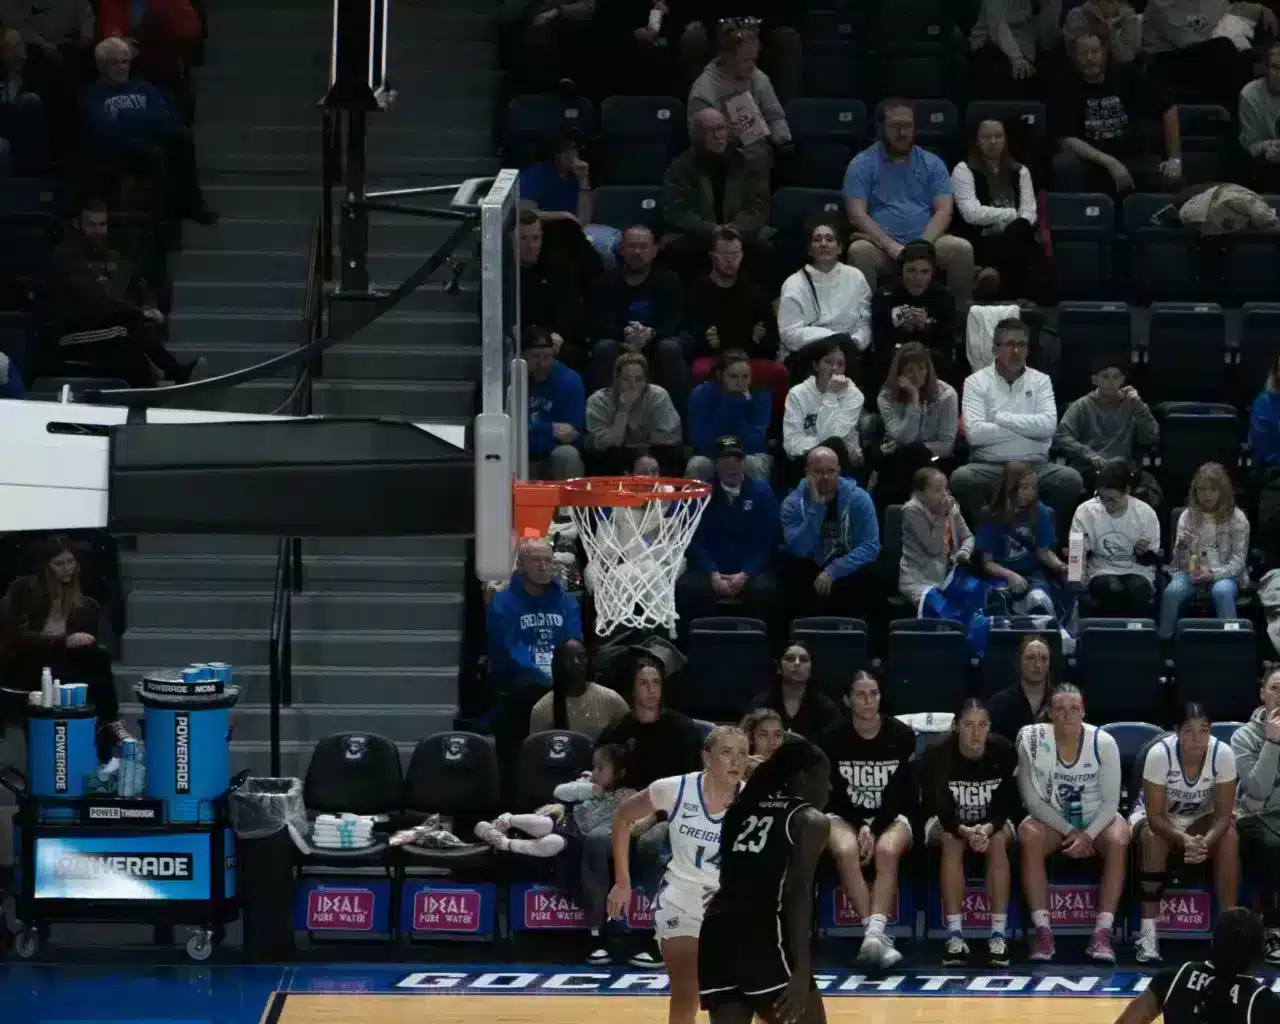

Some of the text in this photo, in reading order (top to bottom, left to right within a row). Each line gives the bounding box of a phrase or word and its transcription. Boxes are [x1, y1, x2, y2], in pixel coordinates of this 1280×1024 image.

[146, 680, 217, 693] POWERADE NCAA
[55, 726, 66, 790] POWERADE
[175, 716, 188, 790] POWERADE
[838, 764, 900, 787] RIGHT
[91, 808, 155, 818] POWER THROUGH
[731, 814, 775, 854] 23
[317, 895, 361, 914] IDEAL
[423, 896, 469, 914] IDEAL
[534, 895, 580, 911] IDEAL
[1050, 892, 1094, 910] IDEAL
[1160, 896, 1198, 914] DEAL
[313, 912, 366, 924] PURE WATER
[419, 913, 472, 925] PURE WATER
[531, 911, 585, 921] PURE WATER
[1176, 916, 1203, 924] WATER
